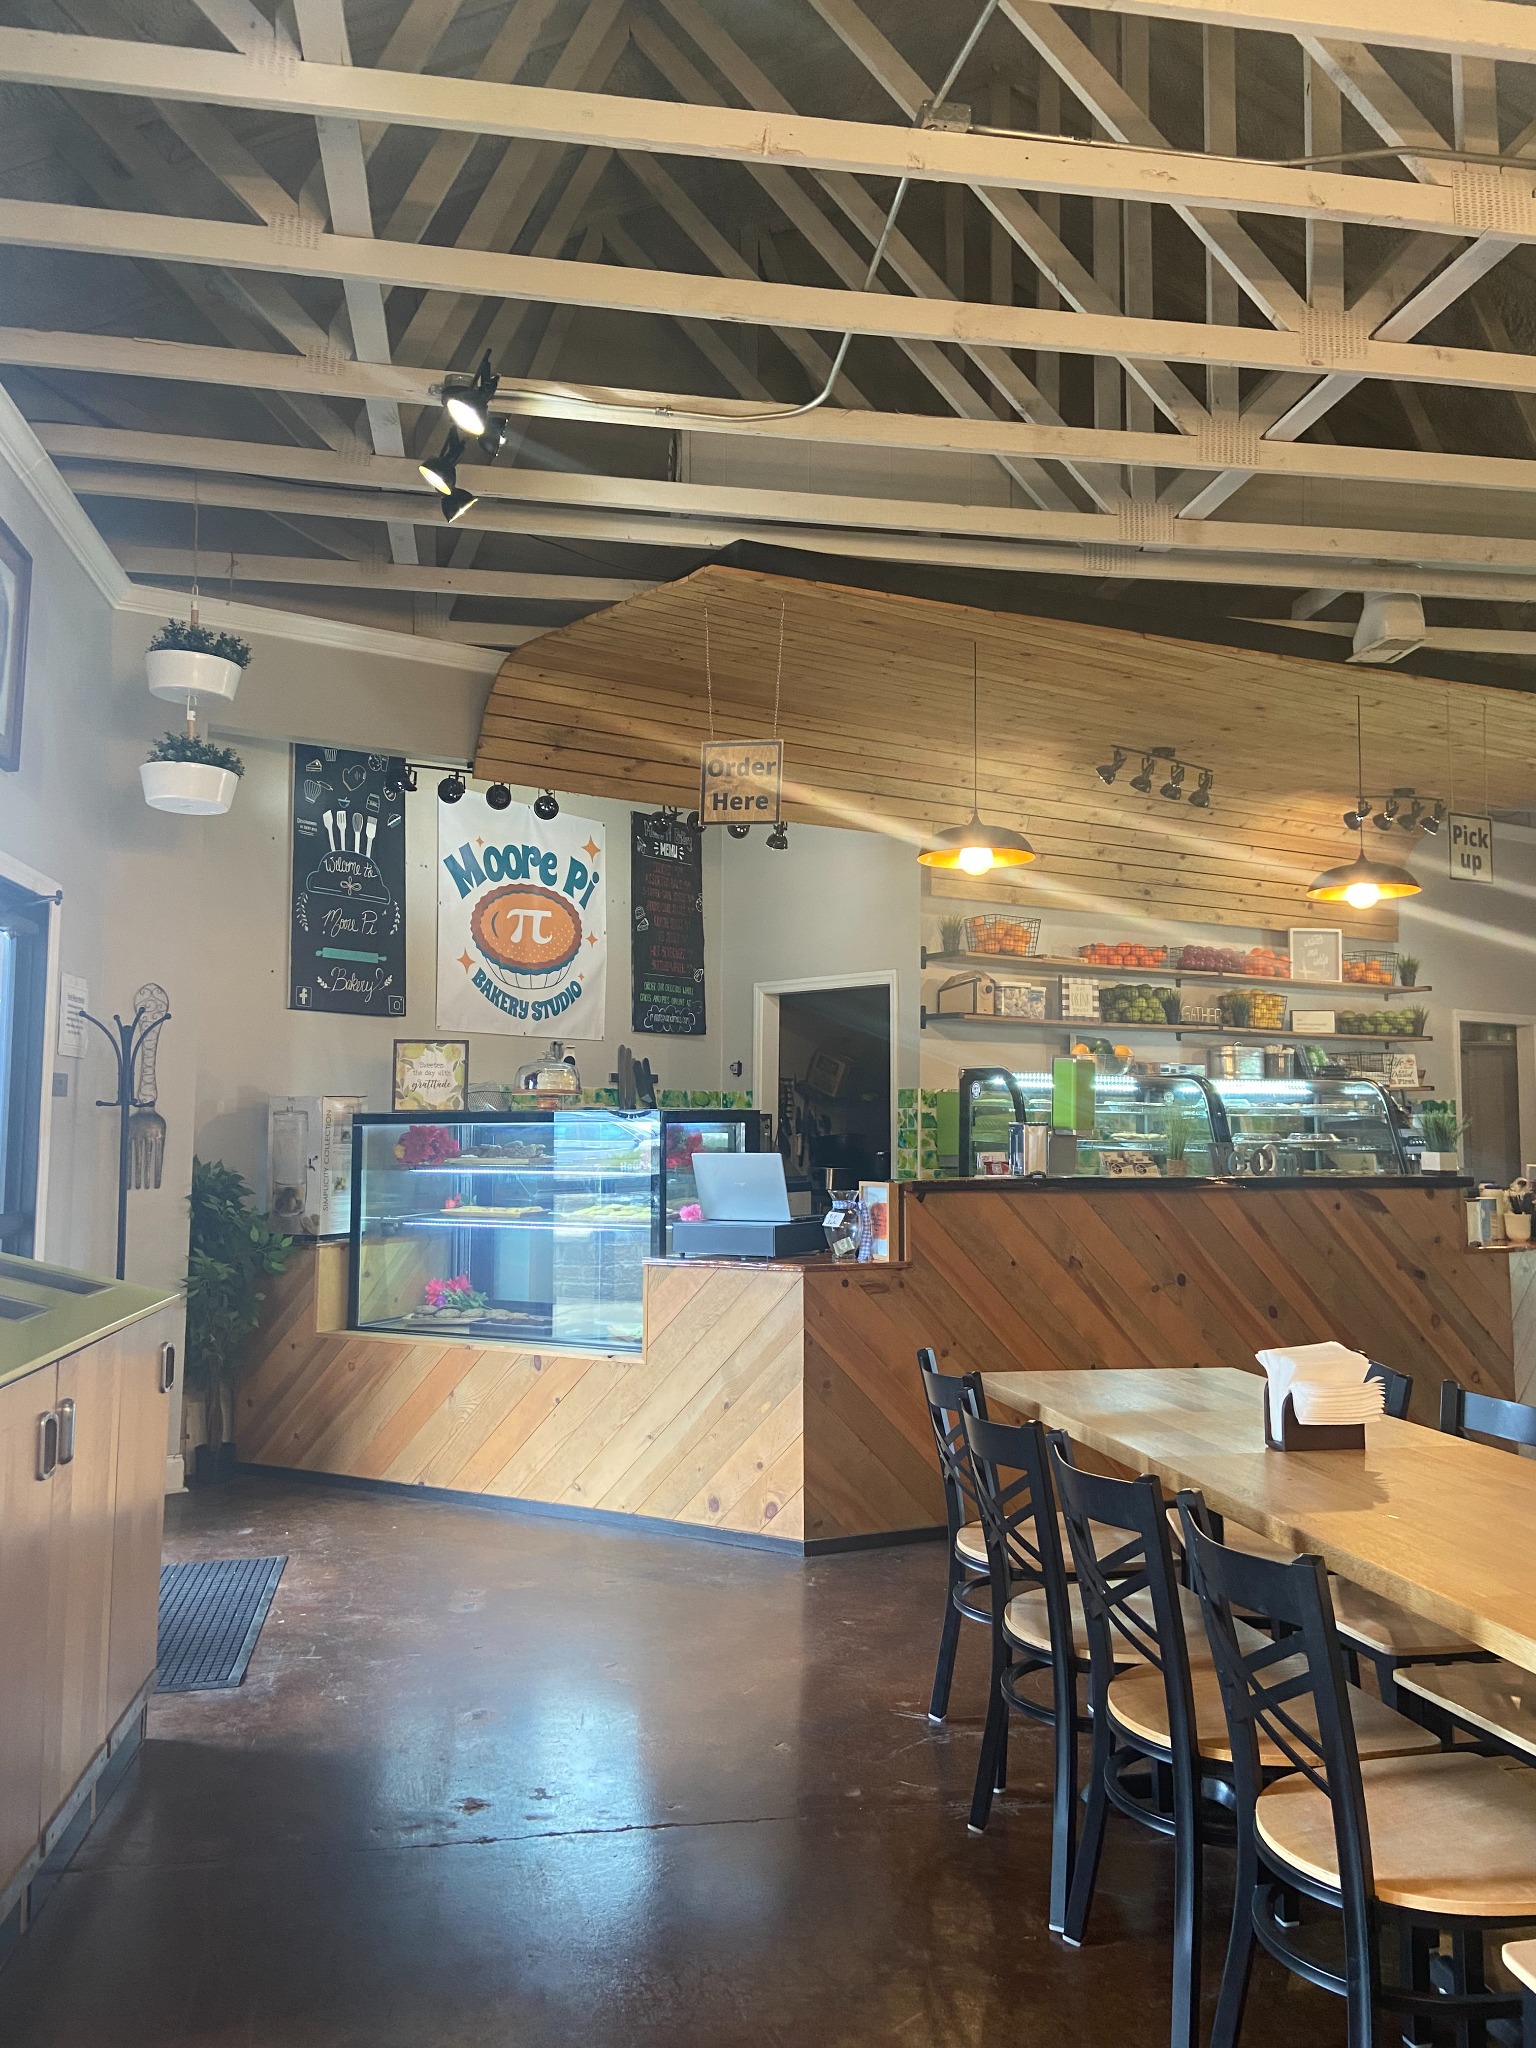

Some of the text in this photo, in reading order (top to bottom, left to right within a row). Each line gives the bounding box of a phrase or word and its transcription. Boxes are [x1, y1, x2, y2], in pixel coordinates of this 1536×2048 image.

[707, 757, 777, 777] Order
[712, 792, 769, 811] Here
[1452, 825, 1489, 849] Pick
[660, 842, 678, 859] MENU
[323, 856, 378, 878] Welcome to
[1461, 853, 1482, 876] up
[443, 842, 600, 910] Moore Pi
[321, 907, 378, 938] Moore Pi
[330, 967, 380, 1003] Bakery
[471, 967, 583, 1021] BAKERY STUDIO
[419, 1061, 445, 1069] Sweeten
[424, 1069, 436, 1078] day
[411, 1078, 452, 1093] gratitude
[322, 1109, 332, 1212] SIMPLICITY COLLECTION
